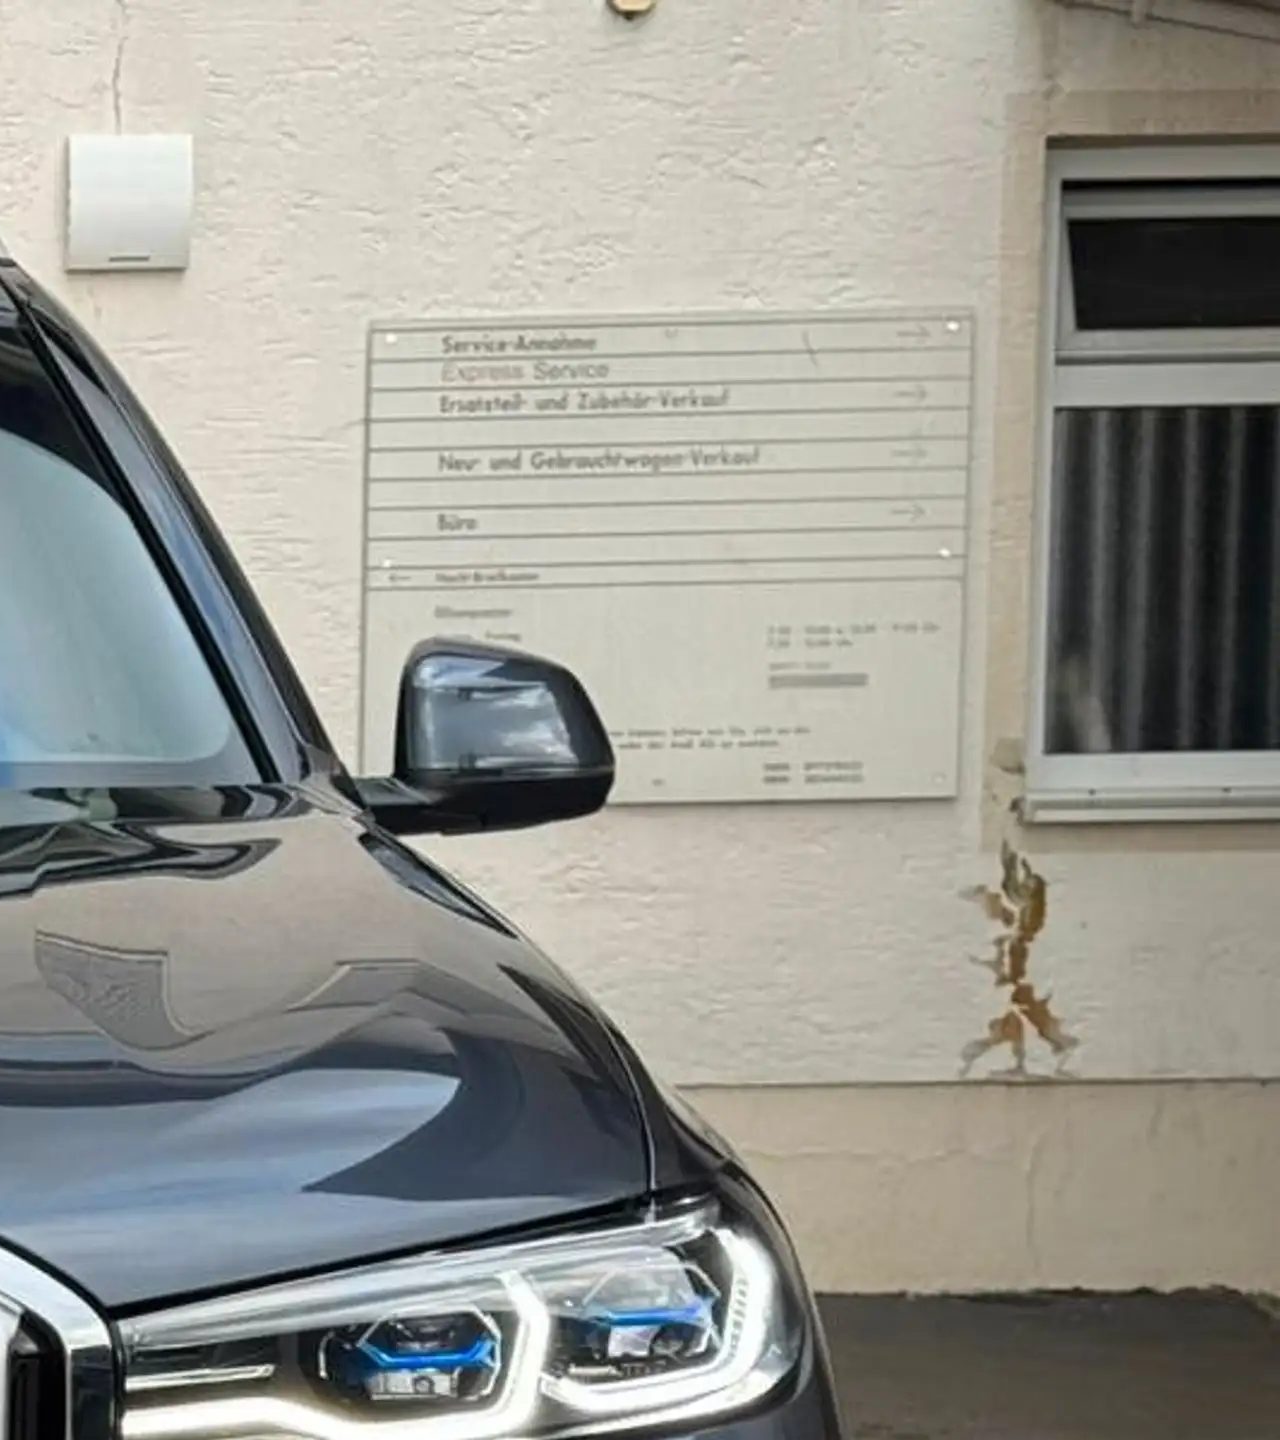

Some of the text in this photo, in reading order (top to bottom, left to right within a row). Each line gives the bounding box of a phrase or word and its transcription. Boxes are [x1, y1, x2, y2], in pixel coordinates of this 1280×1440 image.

[532, 361, 609, 381] Service
[535, 392, 569, 411] und
[489, 449, 522, 471] und
[529, 445, 761, 474] Gebrauchtwagen-Verkauf
[437, 513, 478, 532] Büro
